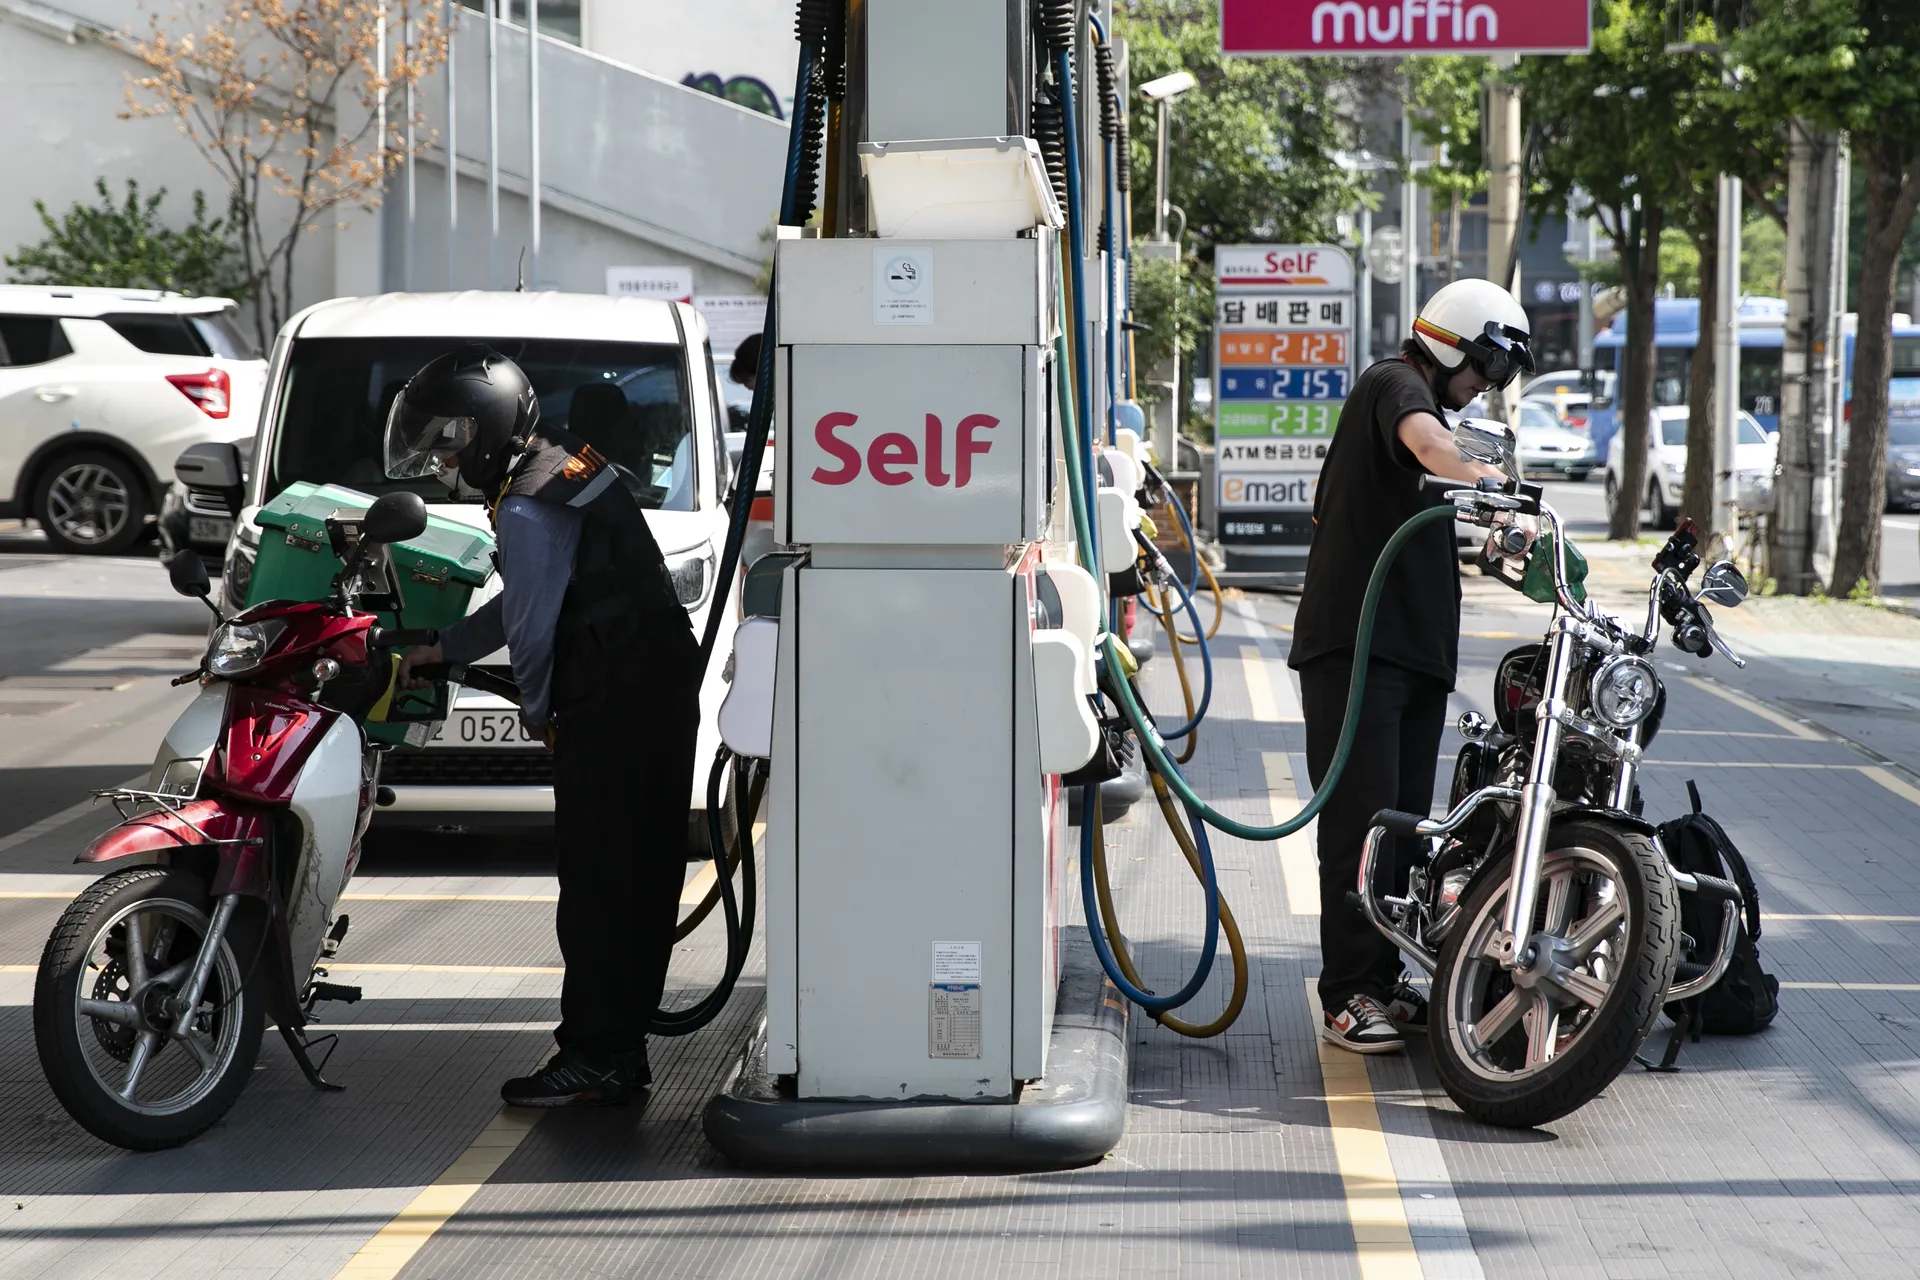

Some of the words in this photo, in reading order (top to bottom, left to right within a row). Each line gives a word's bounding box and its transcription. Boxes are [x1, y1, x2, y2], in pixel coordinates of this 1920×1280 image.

[1311, 0, 1499, 43] muffin
[1265, 251, 1319, 273] Self
[1223, 301, 1342, 324] 담배판매
[1271, 334, 1344, 363] 2127
[1272, 369, 1348, 398] 2157
[1271, 405, 1341, 434] 233
[811, 412, 1000, 488] Self
[1222, 446, 1259, 459] ATM
